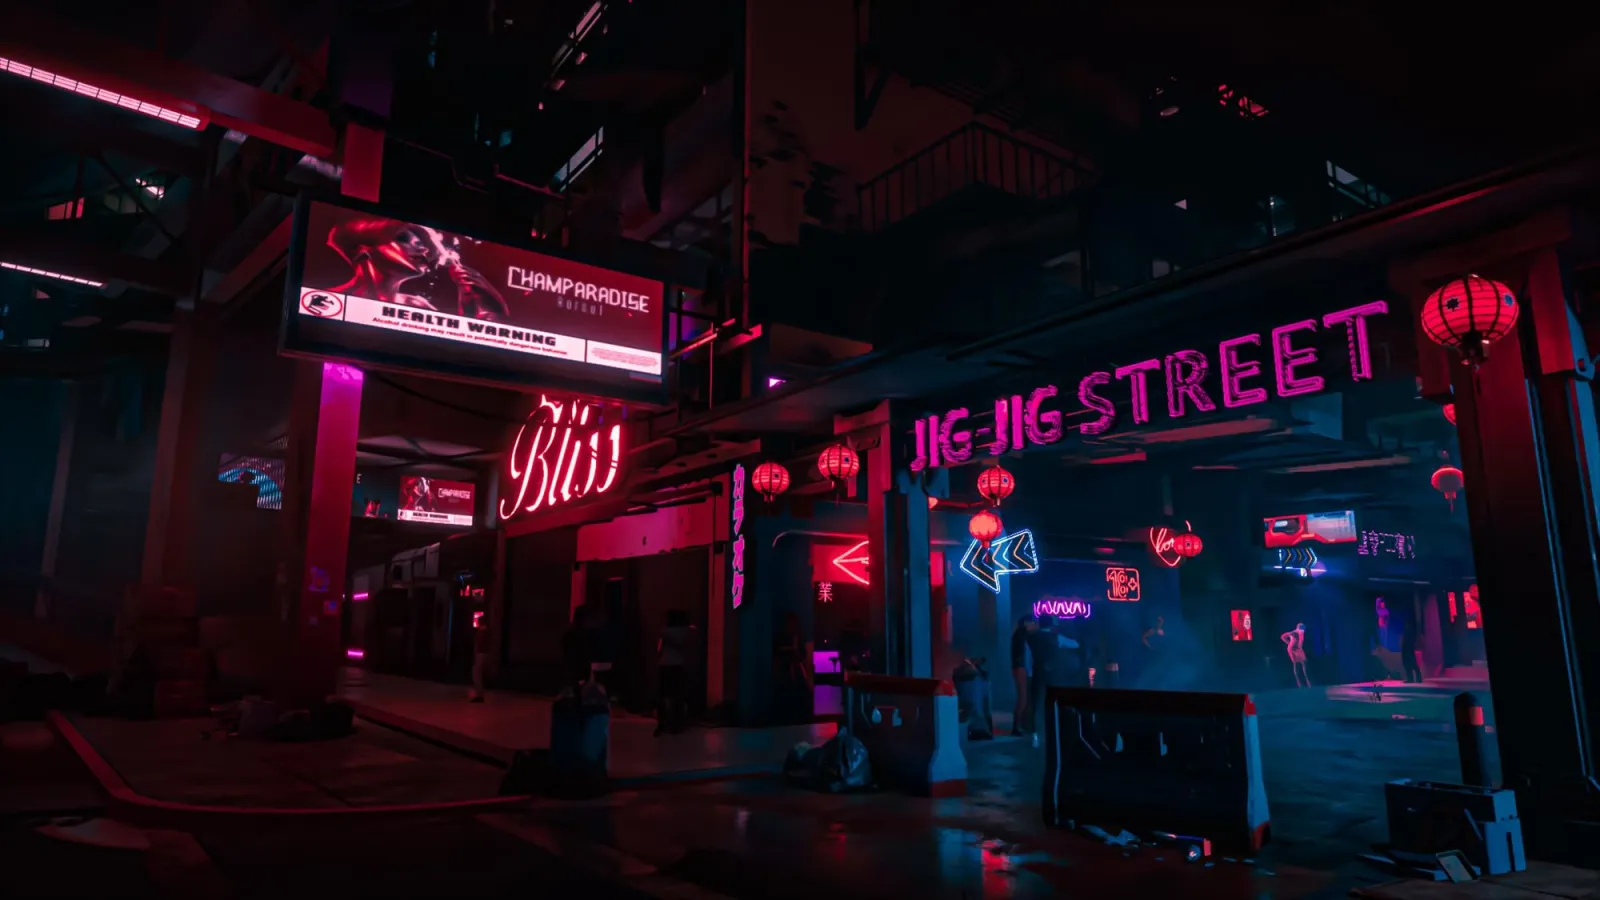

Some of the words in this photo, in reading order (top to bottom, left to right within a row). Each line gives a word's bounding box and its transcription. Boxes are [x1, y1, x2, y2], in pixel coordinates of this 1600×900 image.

[507, 266, 650, 313] CHAMPARADISE
[372, 317, 400, 326] Alcohol
[401, 321, 430, 332] drinking
[431, 327, 444, 335] may
[446, 330, 465, 338] result
[382, 306, 460, 329] HEALTH
[467, 321, 556, 347] WARNING
[909, 384, 1064, 472] JIG-JIG
[1077, 300, 1390, 437] STREET
[1108, 570, 1138, 599] 18+
